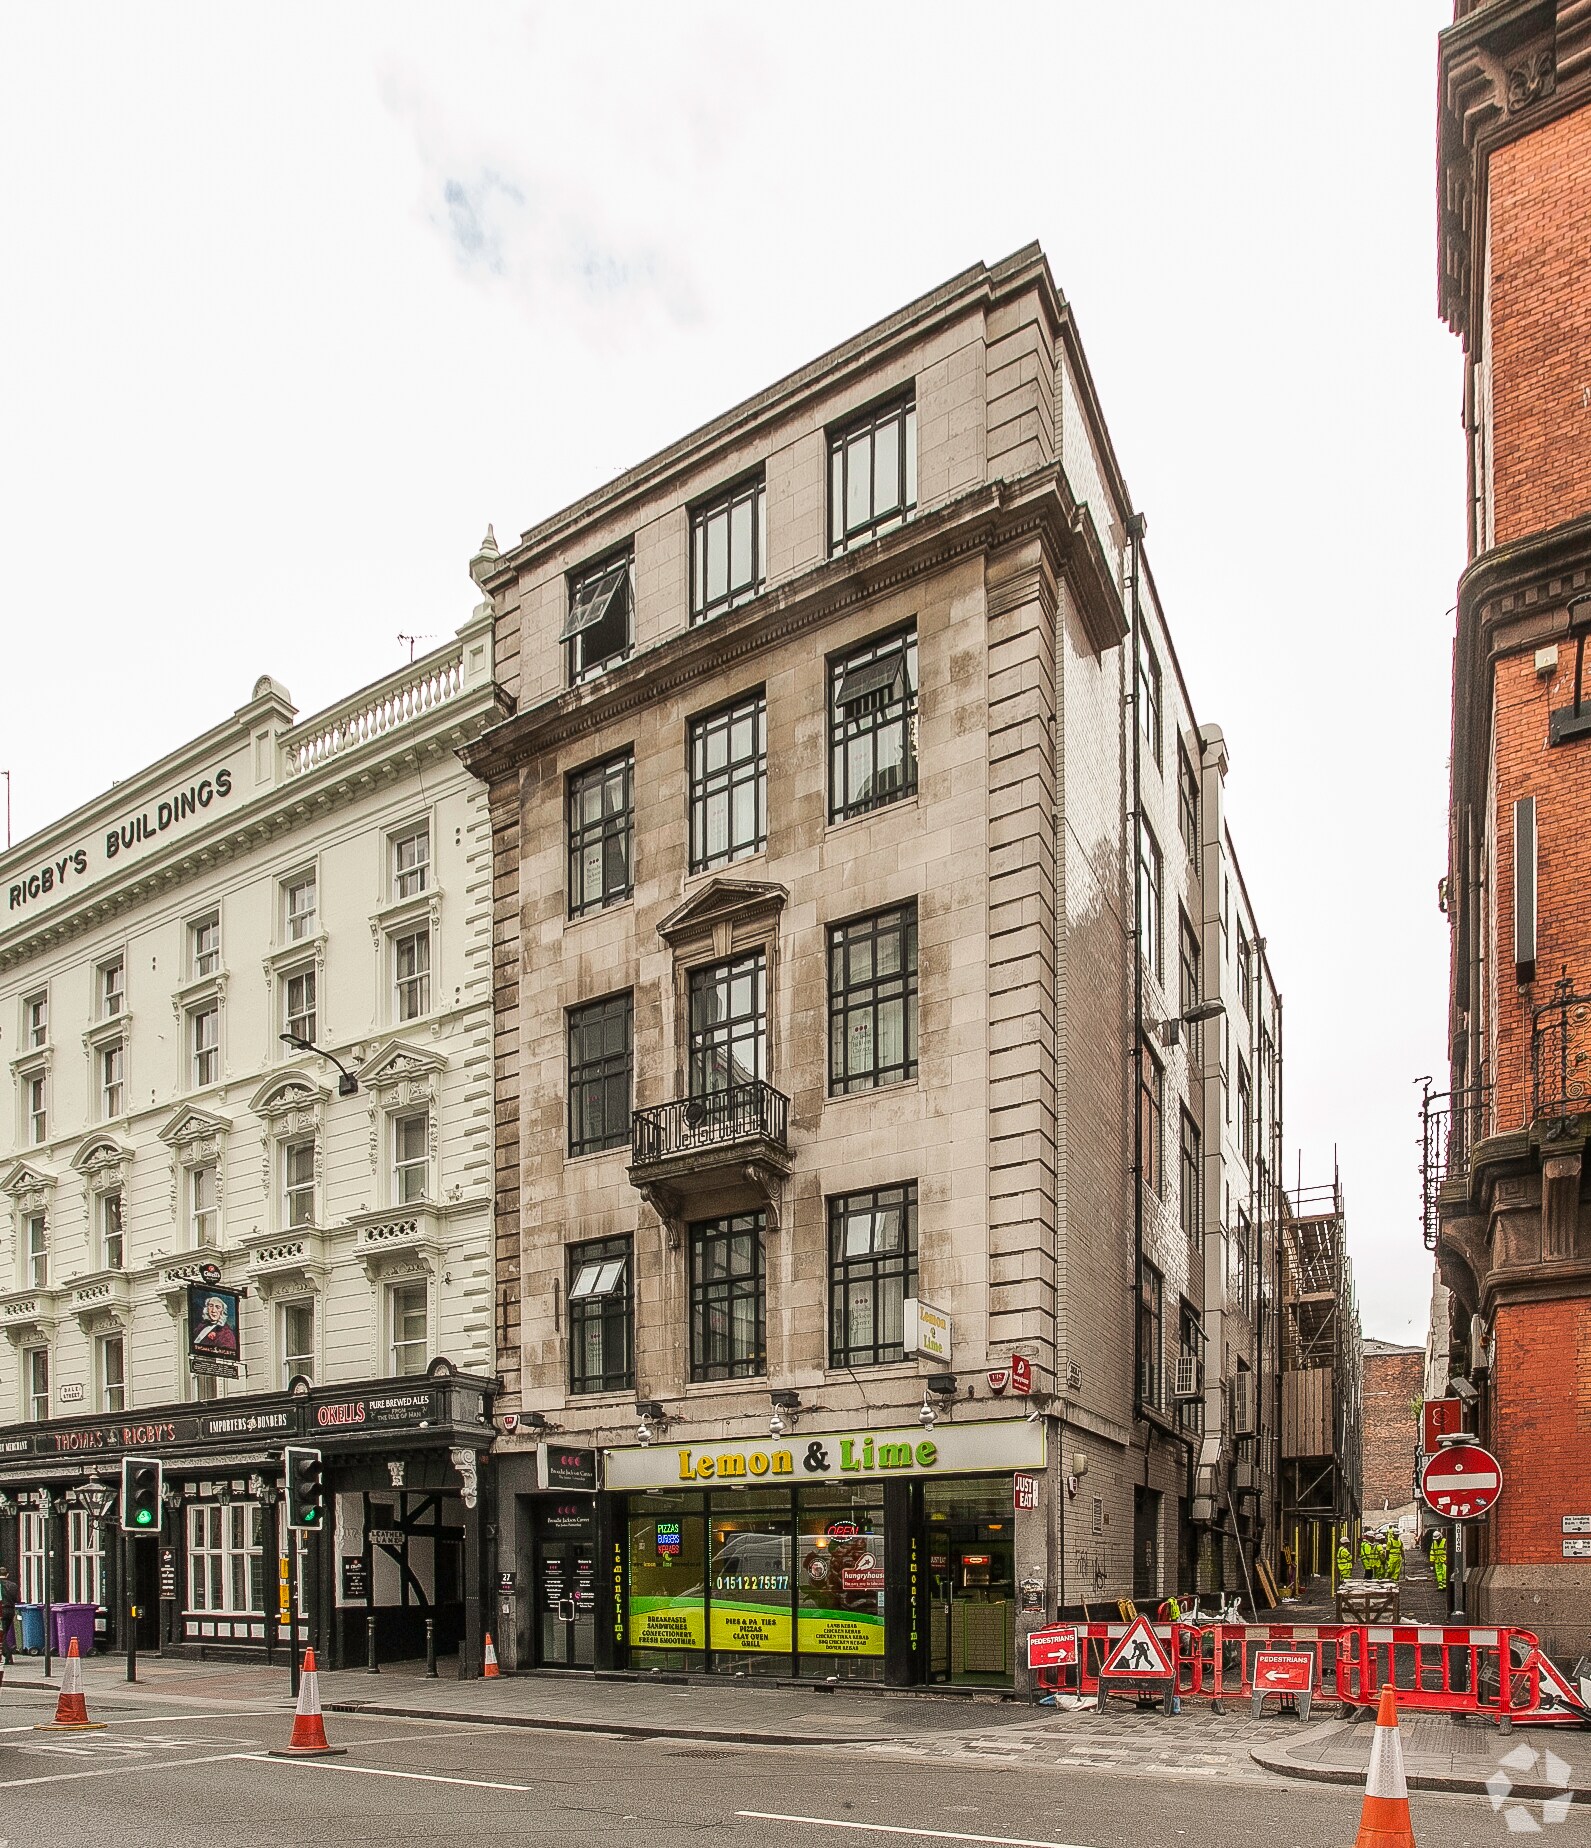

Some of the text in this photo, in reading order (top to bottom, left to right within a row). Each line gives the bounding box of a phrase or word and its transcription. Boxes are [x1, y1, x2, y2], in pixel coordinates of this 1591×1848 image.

[10, 769, 231, 910] RIGBY'S BUILDINGS
[919, 1305, 947, 1330] Lemon
[923, 1334, 943, 1353] Lime
[369, 1395, 429, 1409] PURE BREWED ALES
[318, 1402, 365, 1426] OKELLS
[209, 1418, 246, 1433] IMPORTERS
[257, 1413, 287, 1428] BONDERS
[54, 1424, 175, 1450] THOMAS RIGBY'S
[678, 1437, 937, 1481] Lemon & Lime
[1015, 1476, 1033, 1493] JUST
[1019, 1493, 1033, 1507] EAT
[657, 1524, 679, 1533] PIZZAS
[827, 1525, 859, 1536] OPEN
[657, 1534, 680, 1544] BURGERS
[502, 1573, 511, 1581] 27
[647, 1616, 687, 1624] BREAKFASTS
[642, 1630, 692, 1638] CONFECTIONERY
[750, 1633, 769, 1641] OVEN
[1030, 1634, 1075, 1645] PEDESTRIANS
[638, 1636, 696, 1645] FRESH SMOOTHIES
[741, 1640, 760, 1648] GRILL
[1260, 1656, 1308, 1664] PEDESTRIANS
